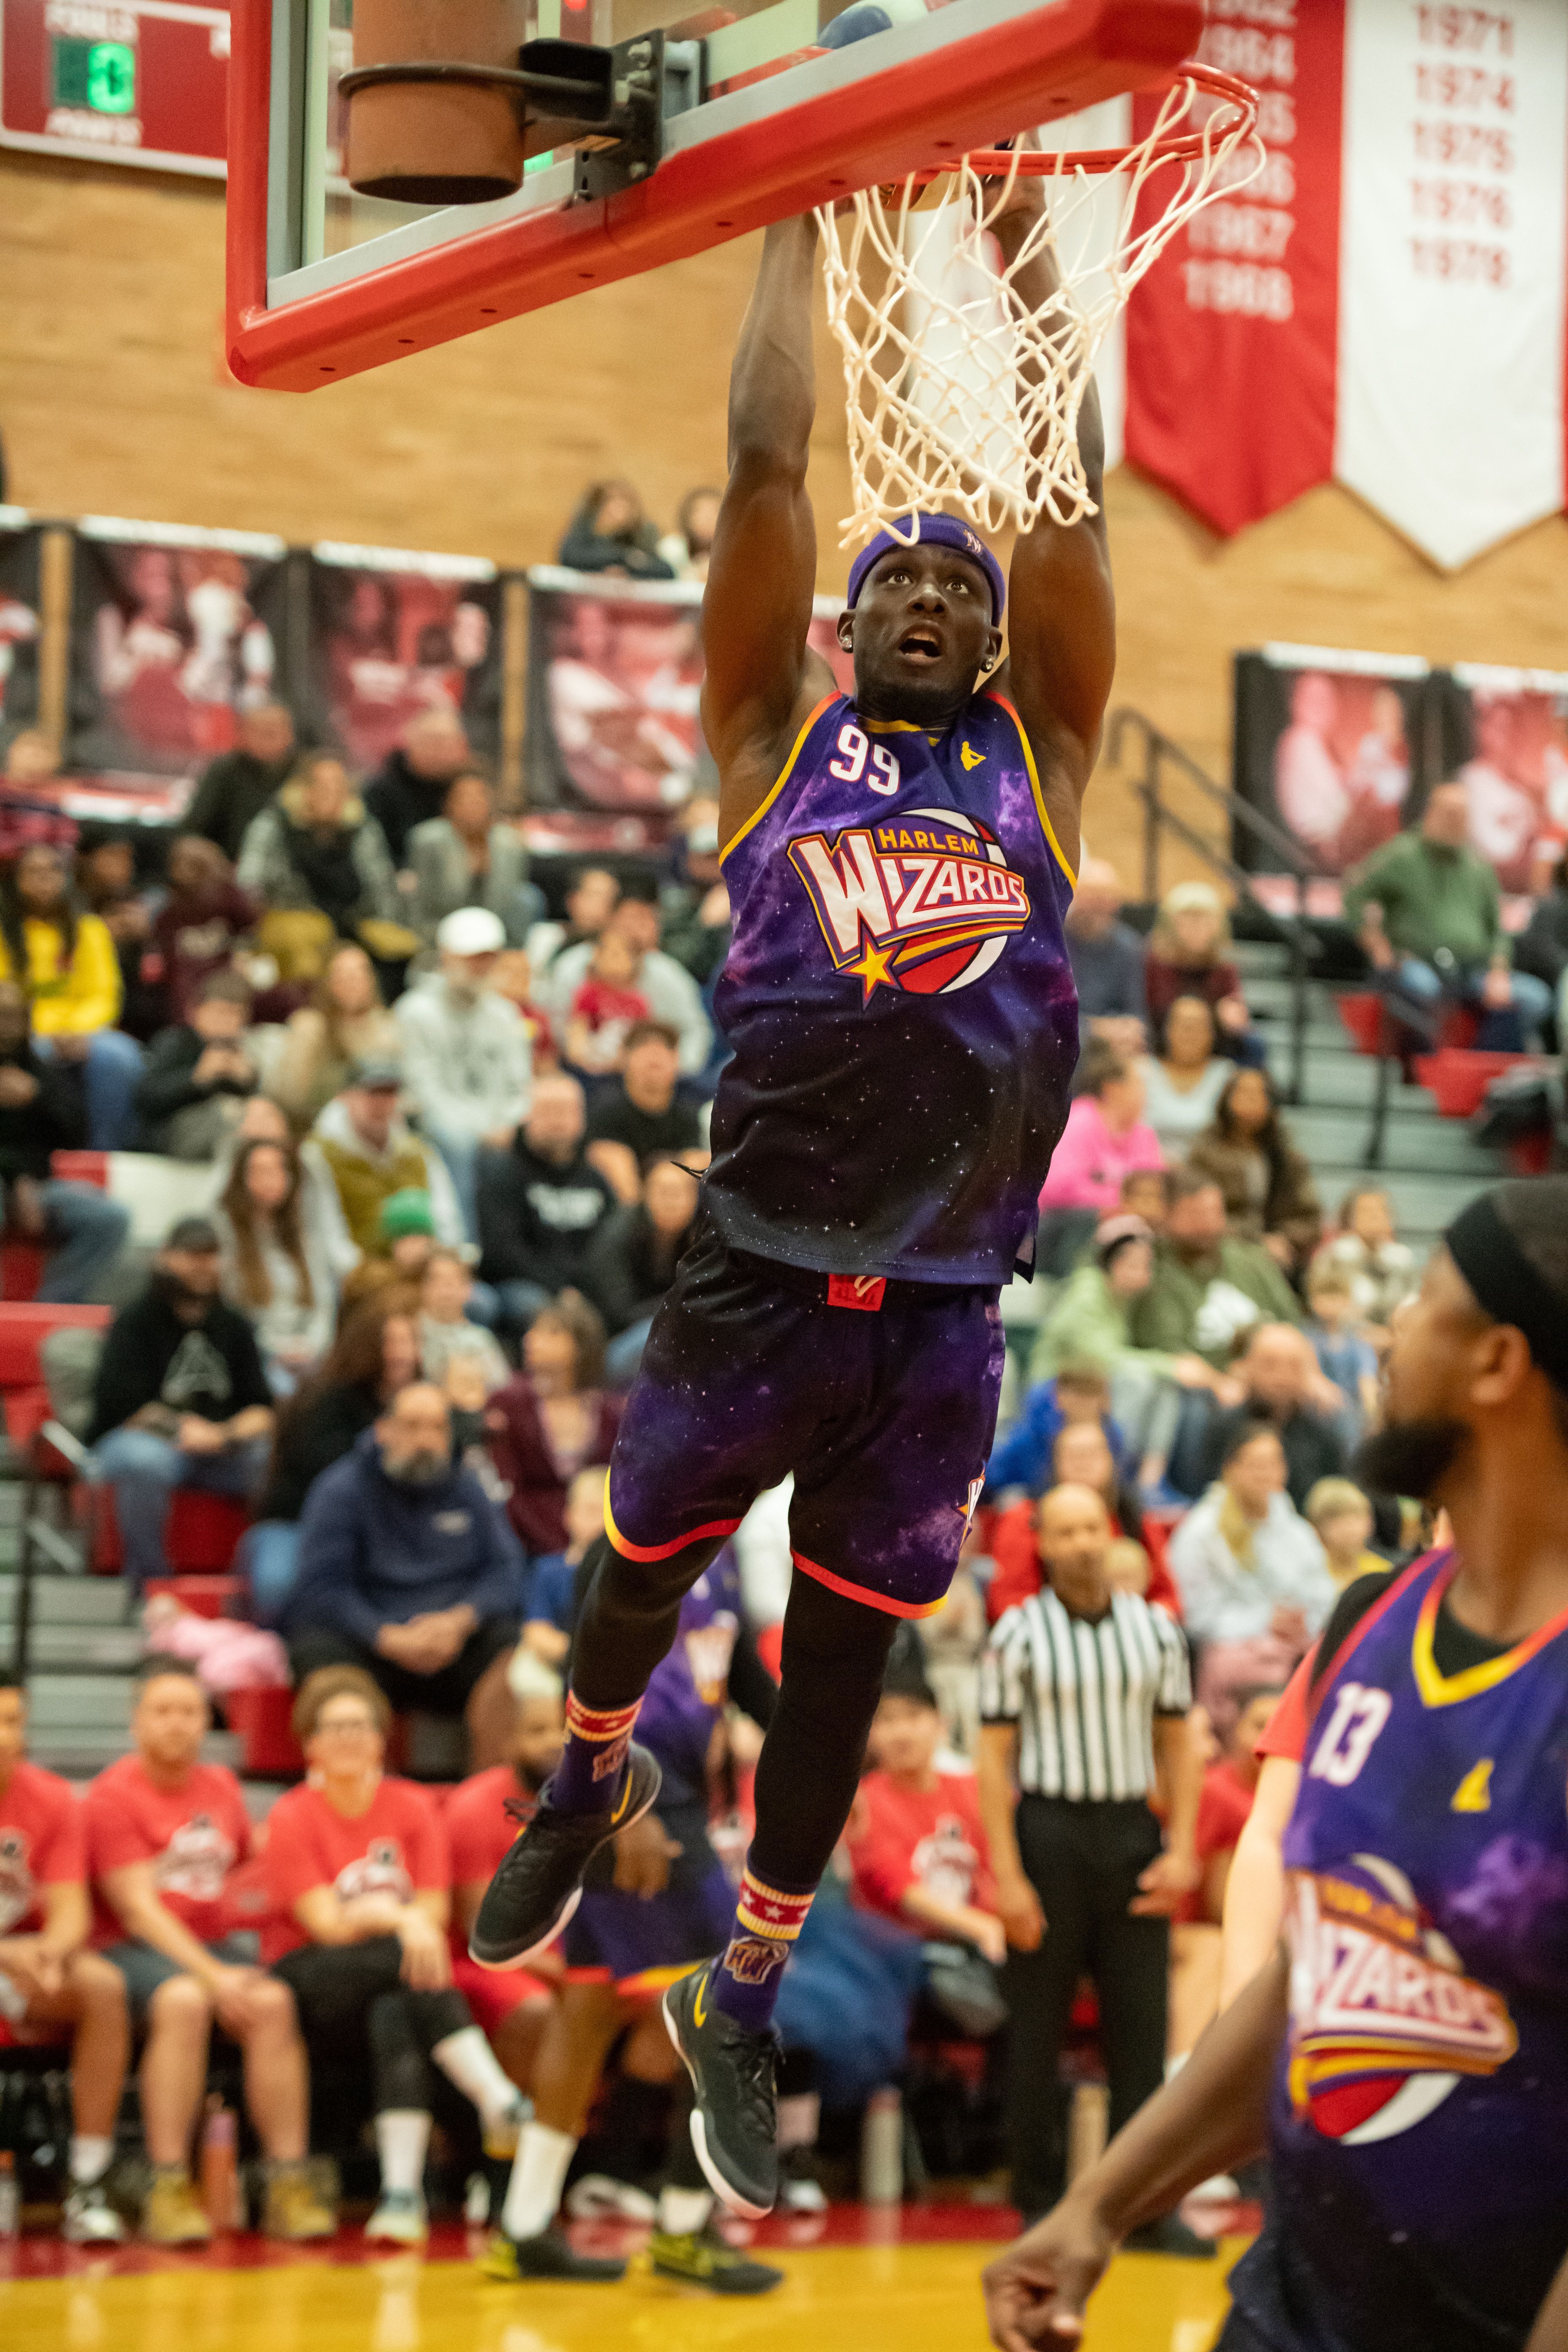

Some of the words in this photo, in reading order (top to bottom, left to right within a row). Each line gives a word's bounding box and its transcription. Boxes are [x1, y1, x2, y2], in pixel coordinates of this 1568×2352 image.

[829, 724, 900, 796] 99
[878, 828, 979, 855] HARLEM
[797, 833, 1028, 954] WIZARDS
[1310, 1682, 1392, 1786] 13
